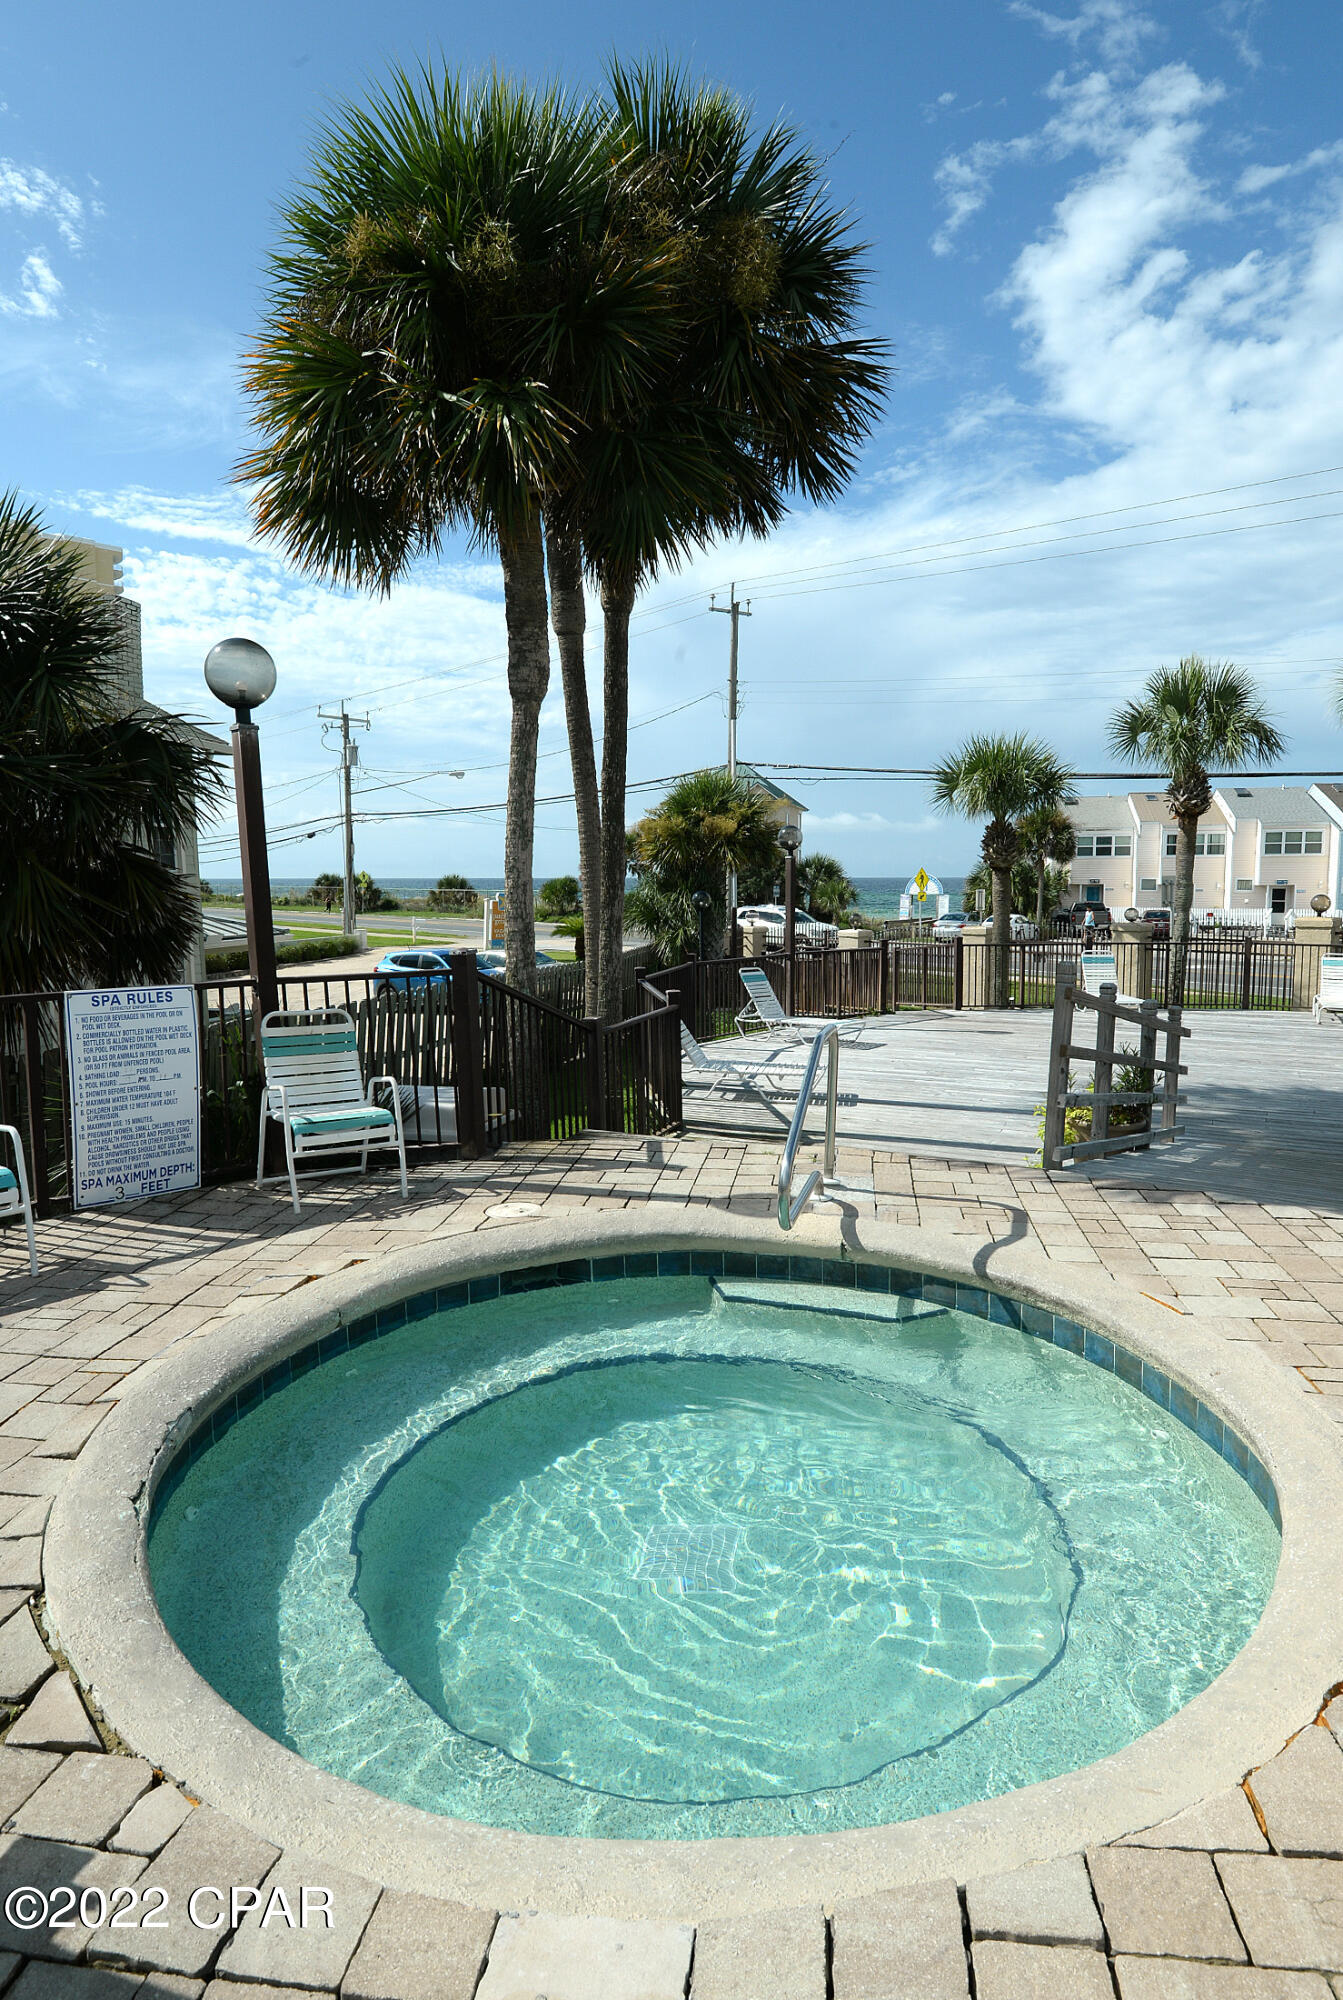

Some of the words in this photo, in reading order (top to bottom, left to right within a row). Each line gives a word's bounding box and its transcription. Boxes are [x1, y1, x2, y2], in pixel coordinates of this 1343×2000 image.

[91, 994, 120, 1006] SPA
[127, 991, 172, 1004] RULES
[82, 1030, 120, 1039] COMMERCIALLY
[116, 1051, 138, 1059] ANIMALS
[123, 1058, 148, 1067] UNFENCED
[107, 1087, 125, 1095] BEFORE
[85, 1097, 110, 1106] MAXIMUM
[129, 1091, 161, 1100] TEMPERATURE
[86, 1106, 110, 1114] CHILDREN
[86, 1121, 111, 1130] MAXIMUM
[87, 1129, 112, 1138] PREGNANT
[102, 1136, 118, 1144] HEALTH
[120, 1132, 145, 1141] PROBLEMS
[112, 1140, 138, 1149] NARCOTICS
[87, 1152, 103, 1160] CAUSE
[105, 1148, 136, 1158] DROWSINESS
[137, 1145, 155, 1153] SHOULD
[87, 1160, 104, 1168] POOLS
[105, 1156, 126, 1165] WITHOUT
[142, 1149, 169, 1159] CONSULTING
[81, 1177, 102, 1190] SPA
[106, 1168, 156, 1186] MAXIMUM
[160, 1161, 194, 1177] DEPTH:
[115, 1186, 125, 1199] 3
[140, 1178, 170, 1194] FEET
